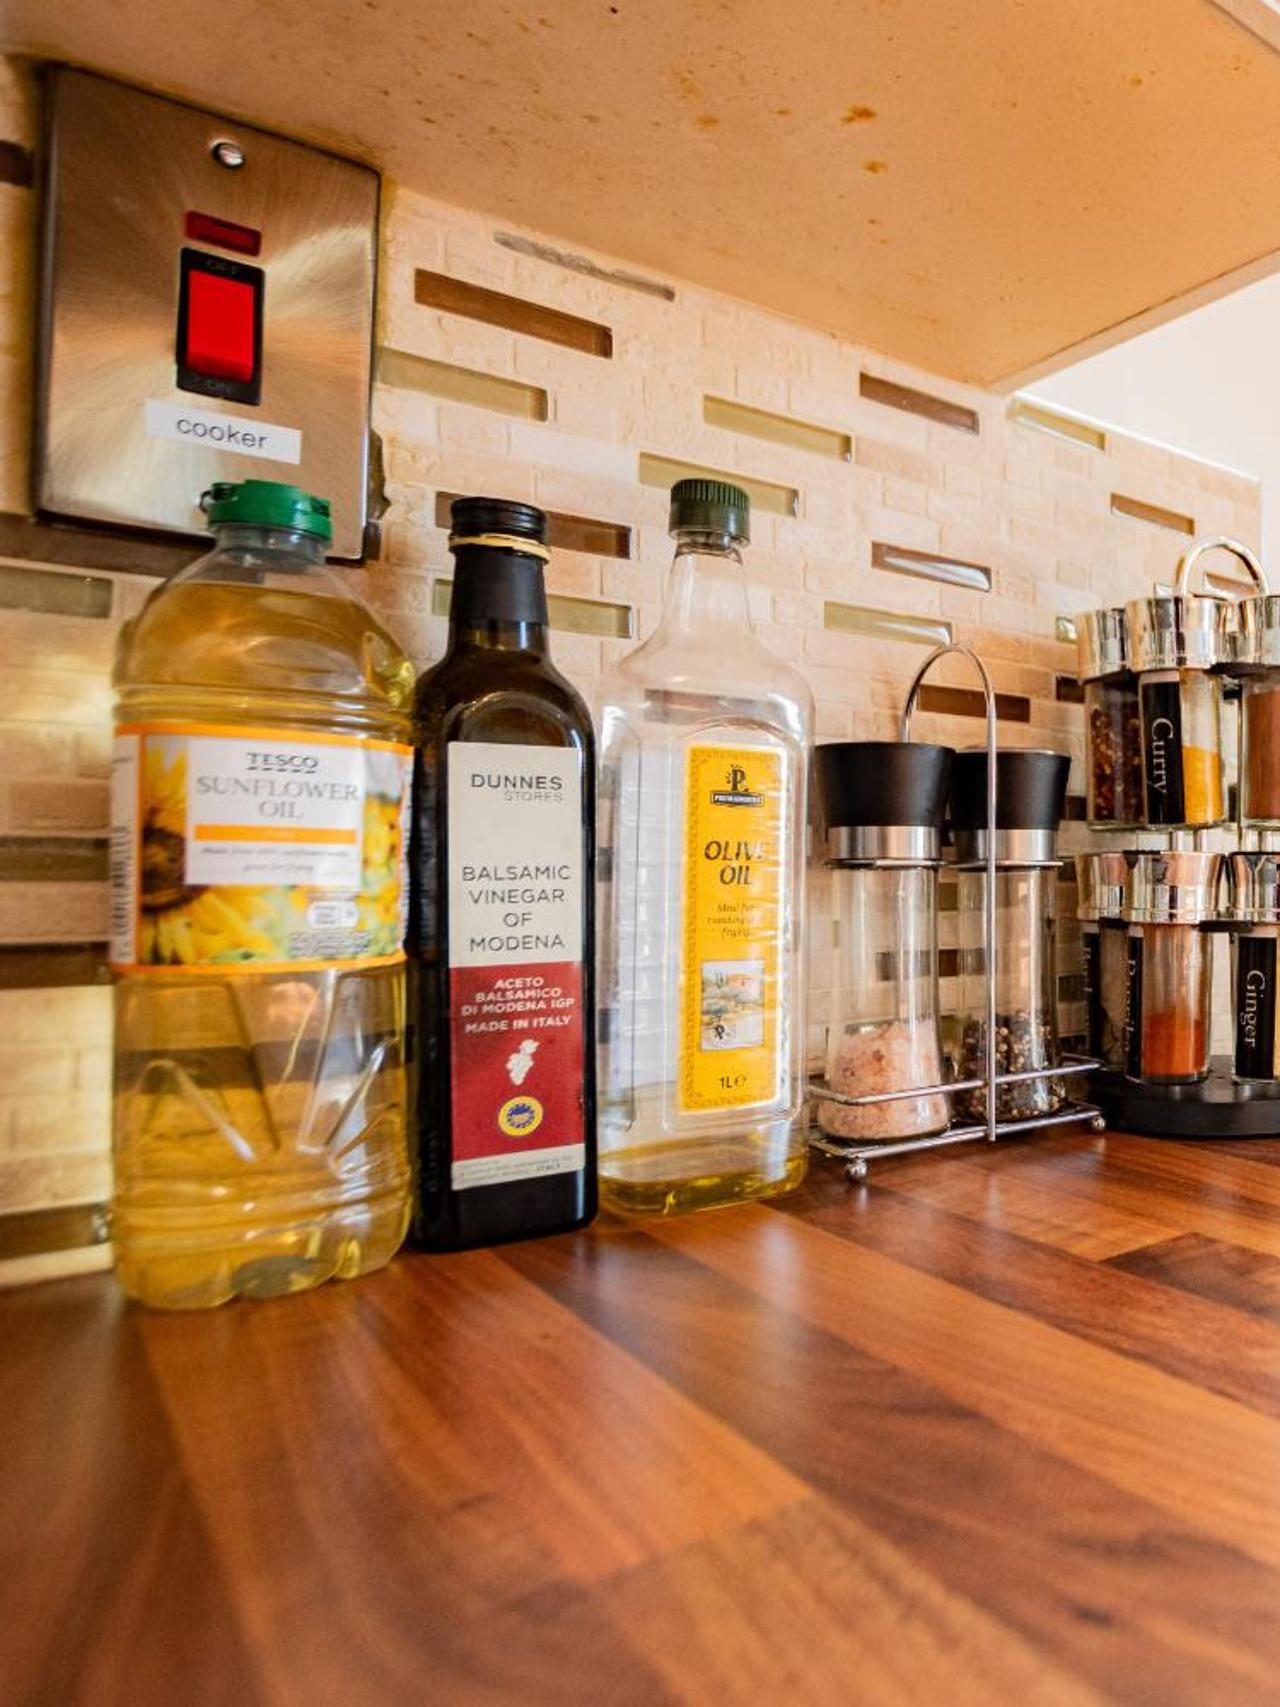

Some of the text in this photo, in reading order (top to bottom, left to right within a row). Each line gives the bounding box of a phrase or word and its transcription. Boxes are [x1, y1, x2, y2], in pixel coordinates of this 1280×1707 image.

[176, 417, 268, 449] cooker
[246, 751, 319, 769] TESCO
[1147, 717, 1174, 795] Curry
[195, 775, 359, 801] SUNFLOWER
[471, 773, 563, 791] DUNNES
[503, 790, 564, 802] STORES
[258, 800, 304, 819] OIL
[462, 865, 571, 882] BALSAMIC
[719, 864, 753, 886] OIL
[468, 888, 565, 905] VINEGAR
[502, 912, 534, 928] OF
[469, 934, 565, 952] MODENA
[494, 976, 545, 990] ACETO
[475, 986, 561, 1003] BALSAMICO
[461, 997, 576, 1017] DI MODENA IGP
[1239, 969, 1266, 1048] Ginger
[464, 1014, 573, 1034] MADE IN ITALY
